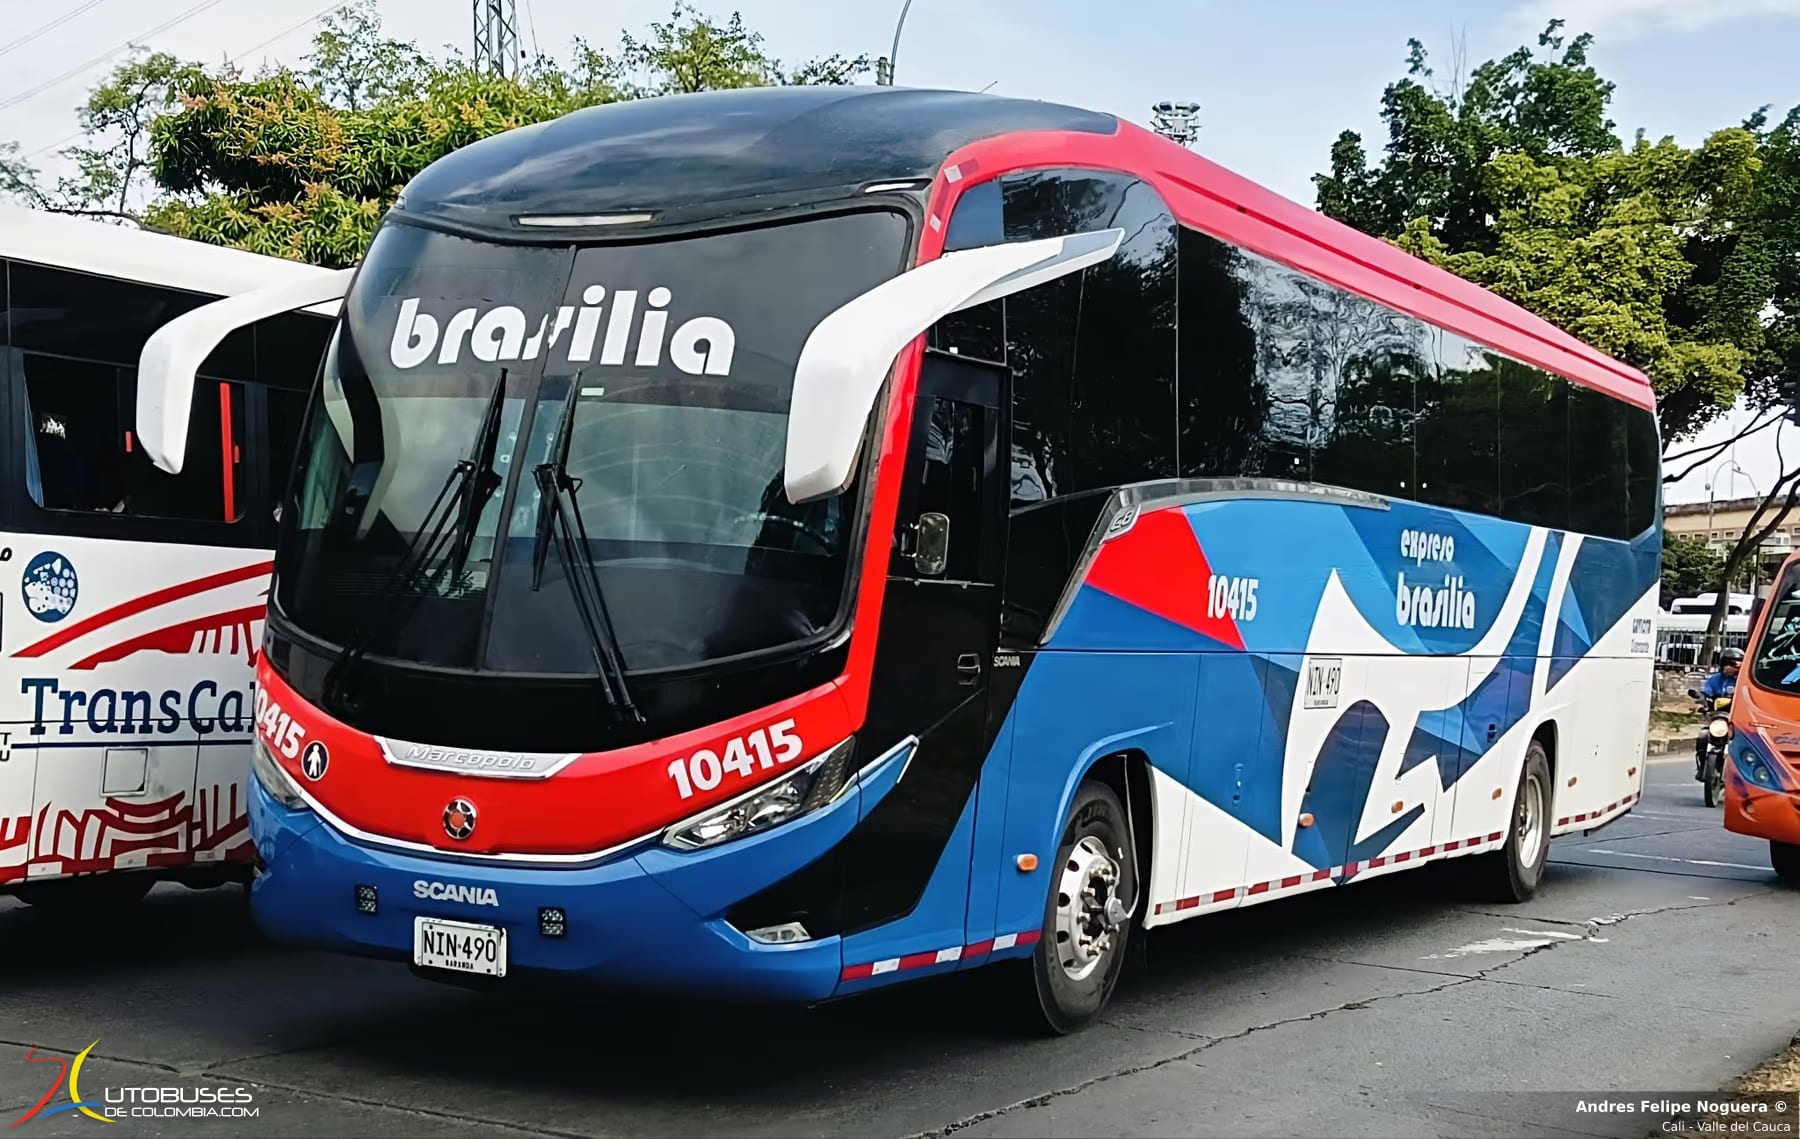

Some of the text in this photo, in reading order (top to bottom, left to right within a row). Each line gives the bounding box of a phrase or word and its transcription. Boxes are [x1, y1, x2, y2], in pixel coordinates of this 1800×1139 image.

[390, 284, 735, 376] brasilia
[1401, 529, 1454, 568] expreso
[1208, 574, 1259, 621] 10415
[1396, 571, 1475, 629] brasilia
[406, 745, 536, 770] Marcopolo
[667, 718, 804, 800] 10415
[413, 880, 500, 907] SCANIA
